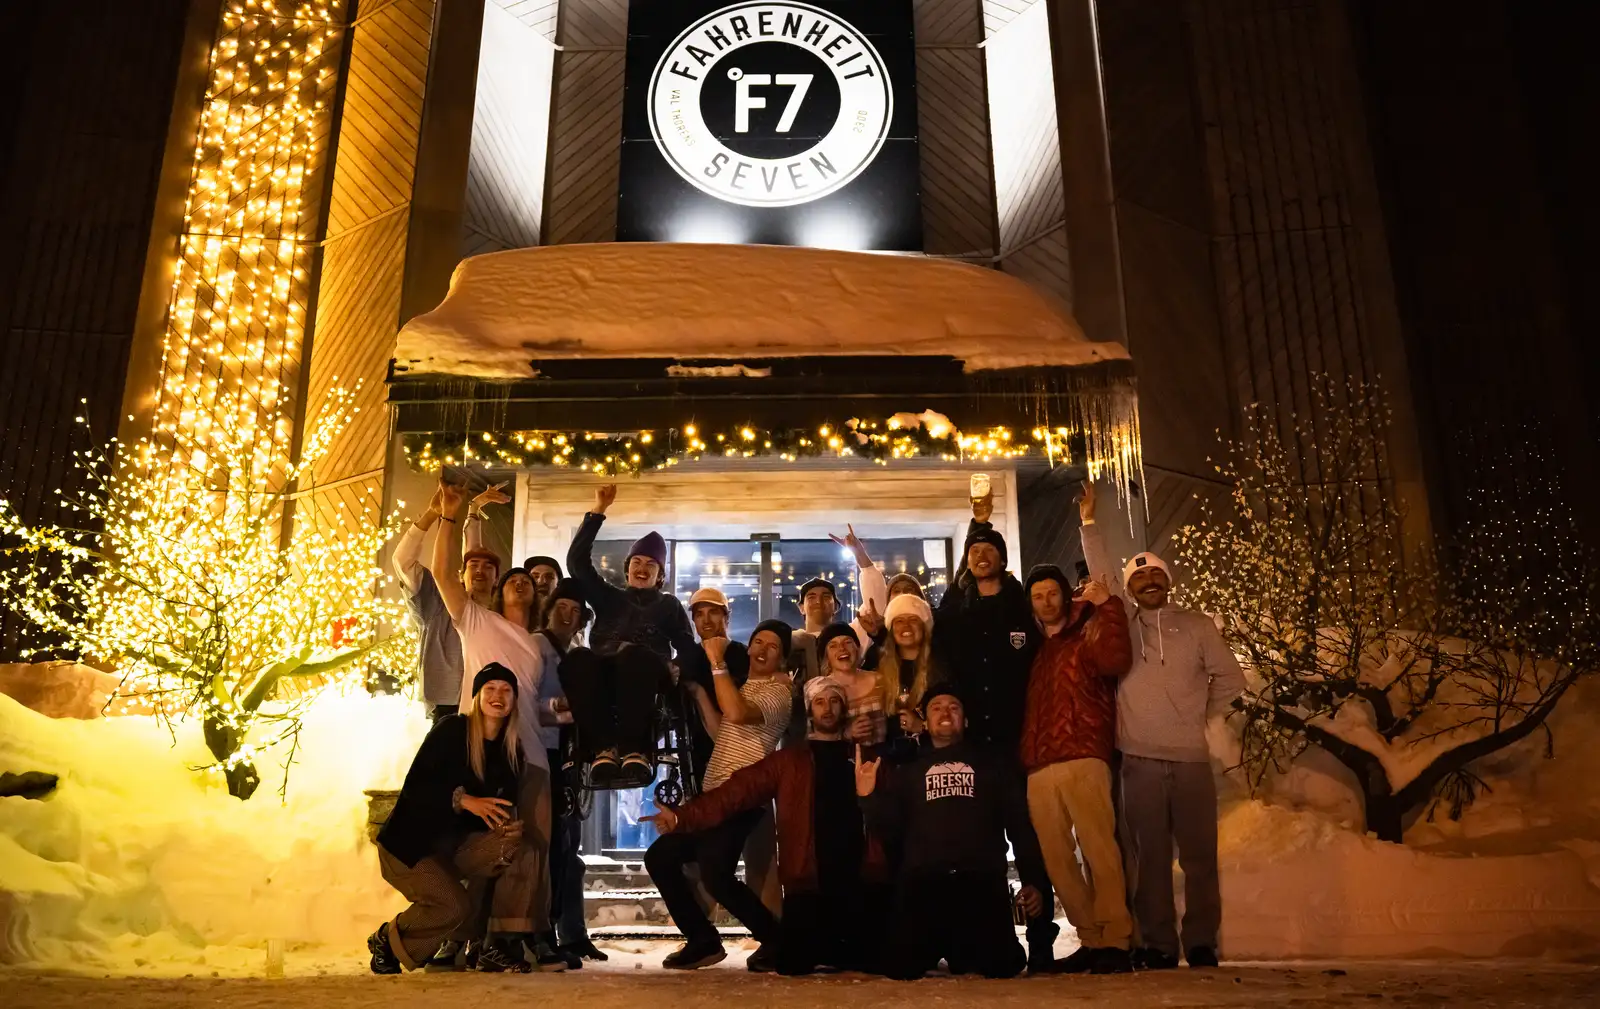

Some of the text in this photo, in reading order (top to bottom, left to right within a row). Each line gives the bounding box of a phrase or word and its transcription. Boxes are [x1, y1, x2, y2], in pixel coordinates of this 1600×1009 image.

[669, 11, 874, 81] FAHRENHEIT
[669, 89, 696, 147] VAL THORENS
[852, 109, 868, 133] 2300
[704, 151, 838, 193] SEVEN
[925, 773, 974, 791] FREESKI
[926, 787, 974, 801] BELLEVILLE
